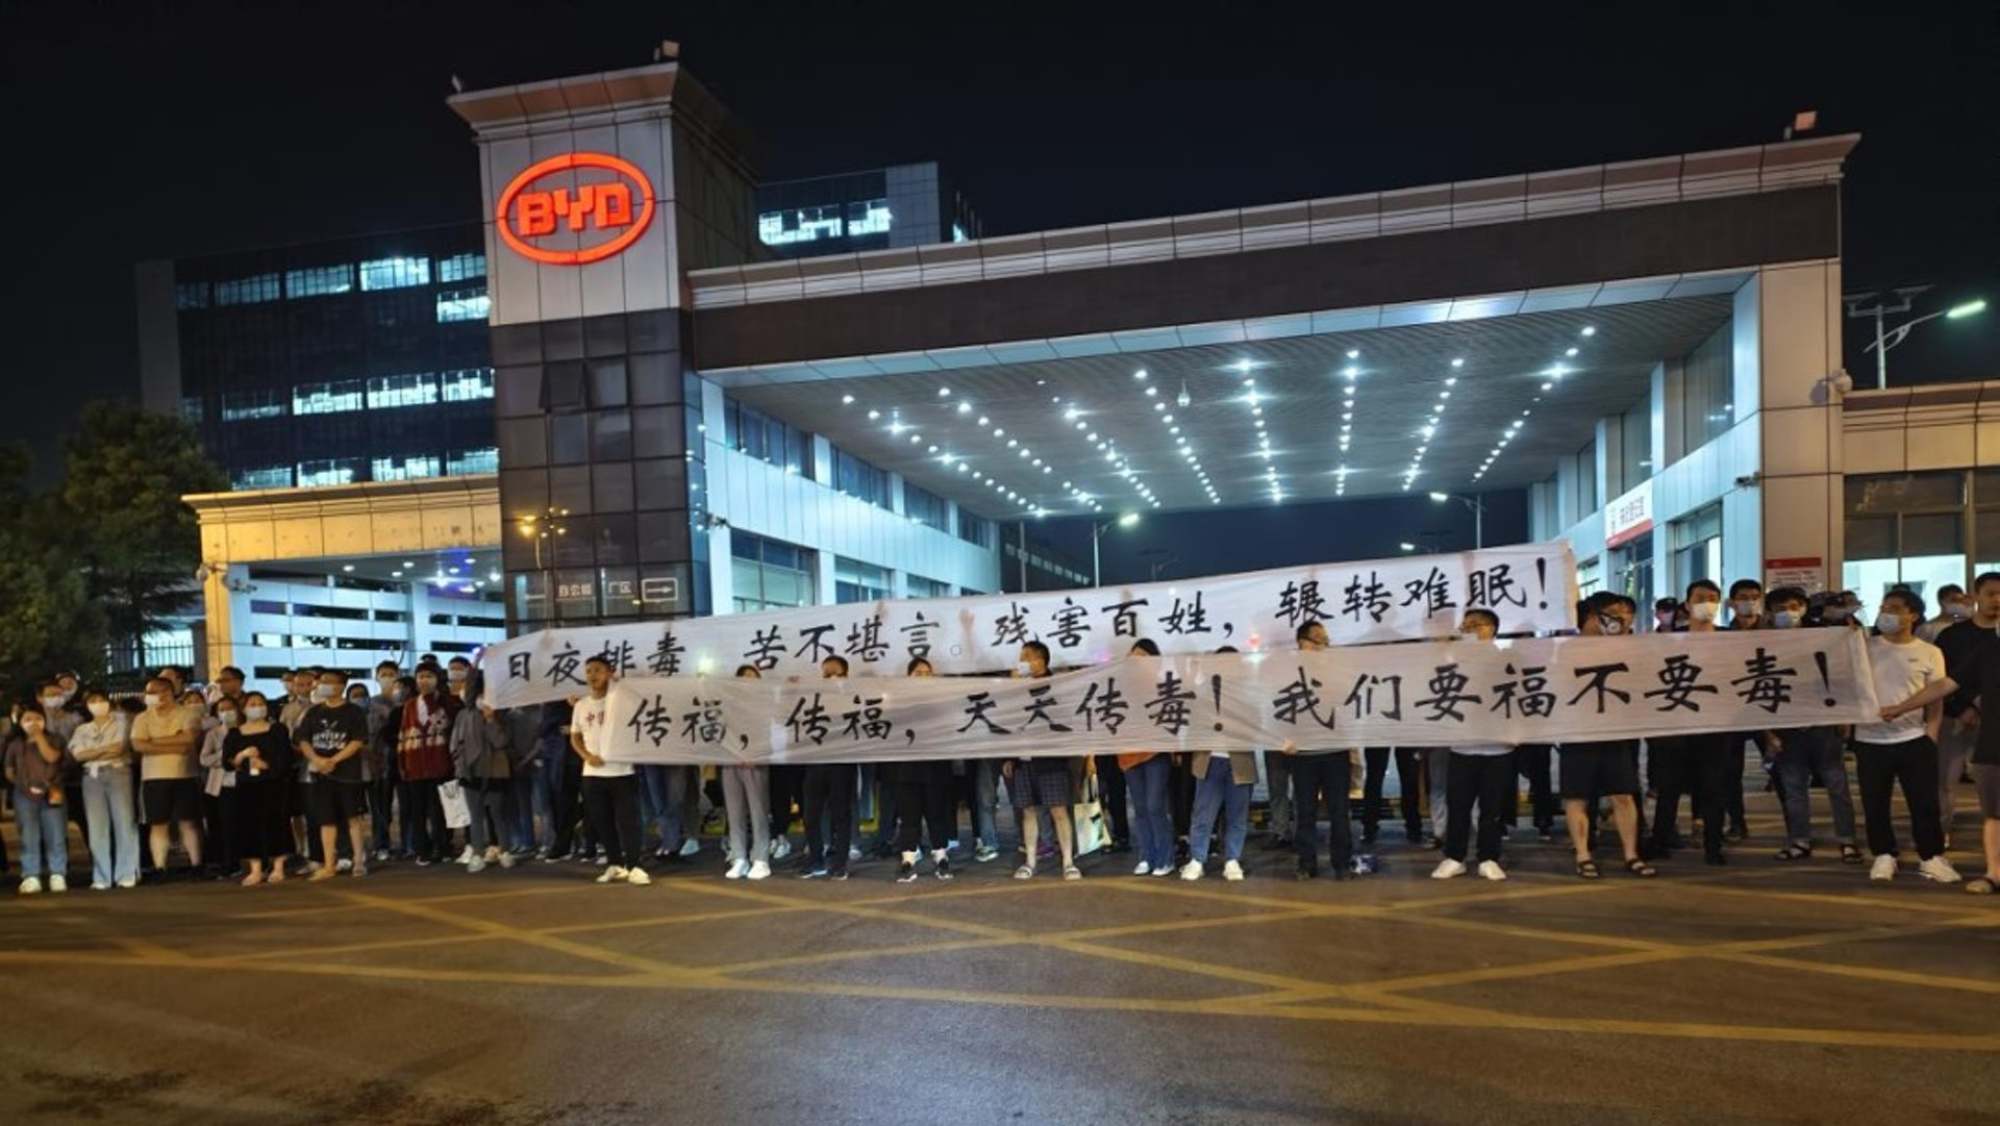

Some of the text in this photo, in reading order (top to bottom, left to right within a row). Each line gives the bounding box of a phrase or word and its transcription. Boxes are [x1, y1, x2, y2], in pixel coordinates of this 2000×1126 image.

[517, 182, 633, 237] BYD
[509, 631, 686, 687] 日夜排毒
